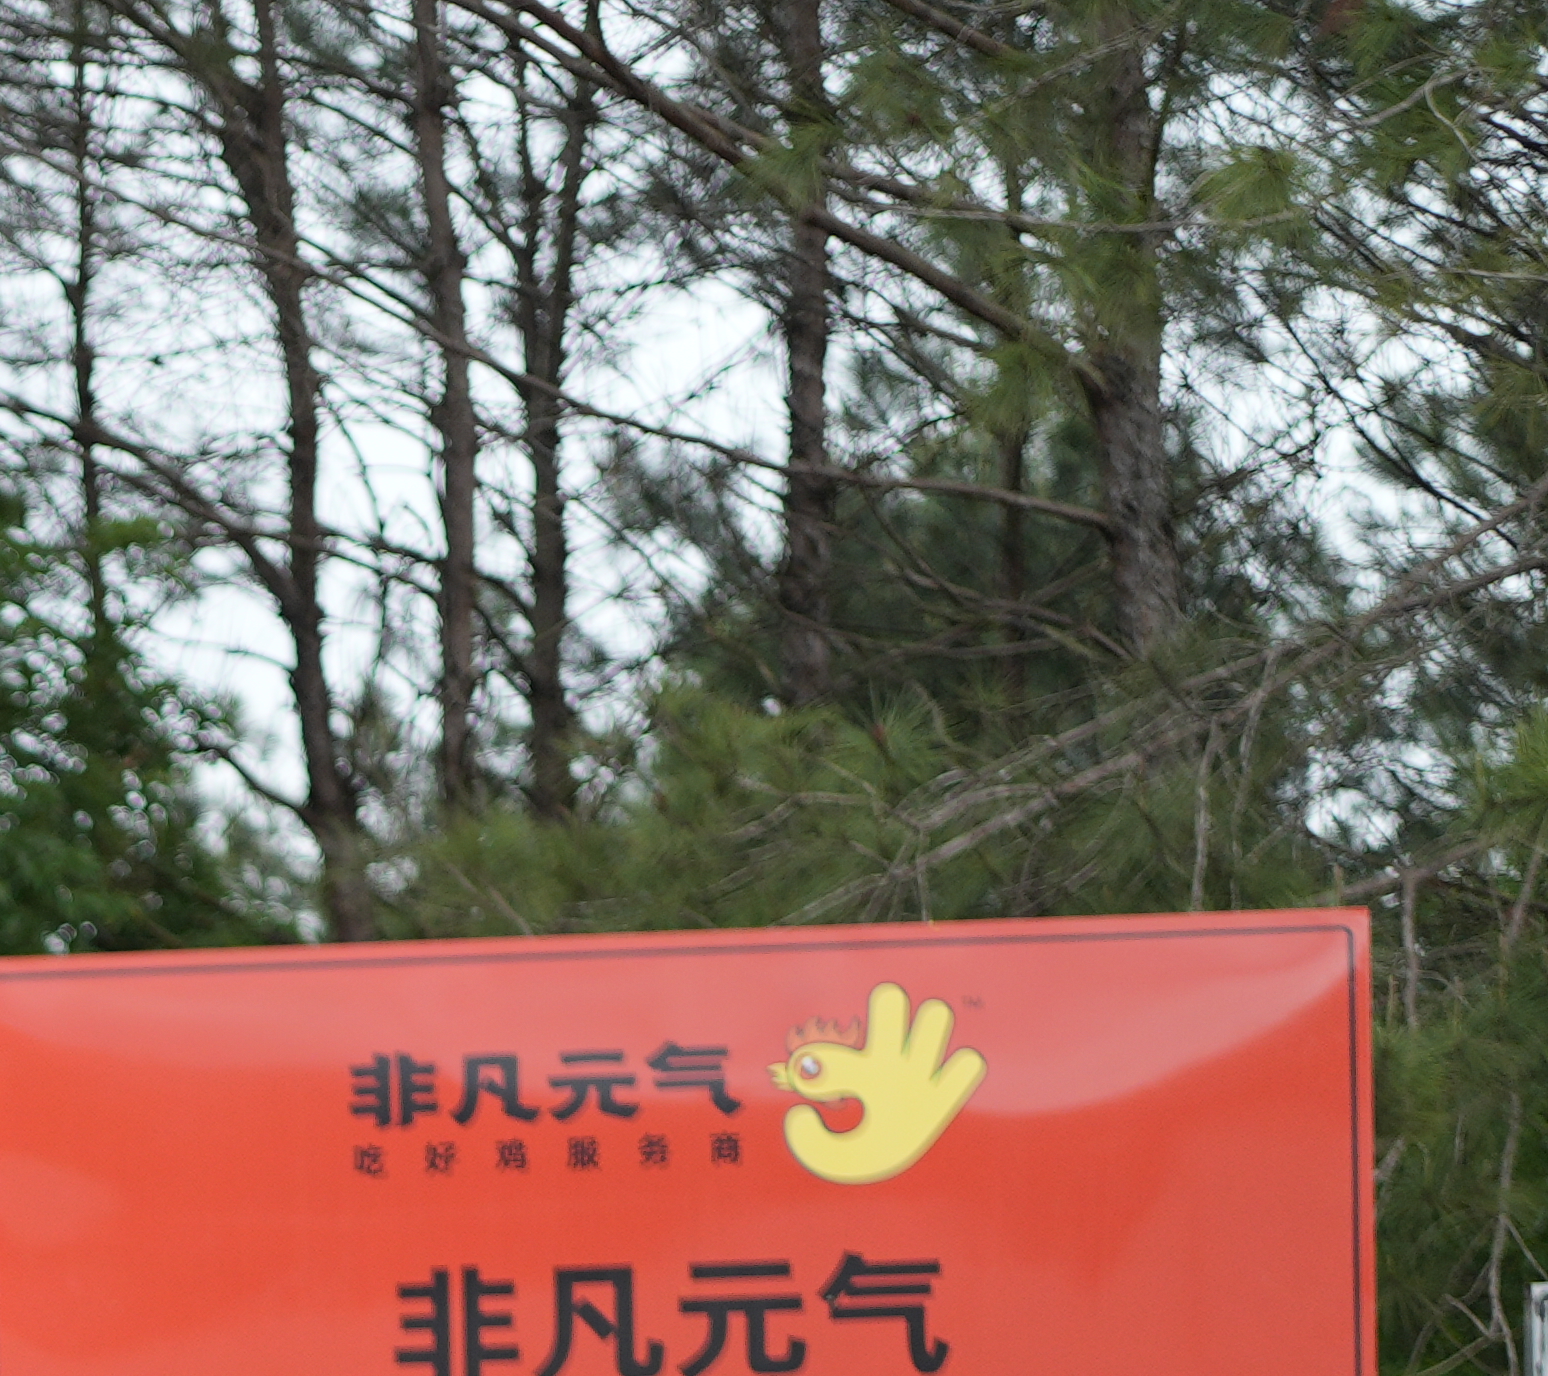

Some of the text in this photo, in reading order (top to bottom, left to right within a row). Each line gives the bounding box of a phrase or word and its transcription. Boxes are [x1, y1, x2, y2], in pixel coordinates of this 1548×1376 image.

[350, 1042, 742, 1127] 非凡元气
[355, 1132, 741, 1176] 吃好鸡服务商
